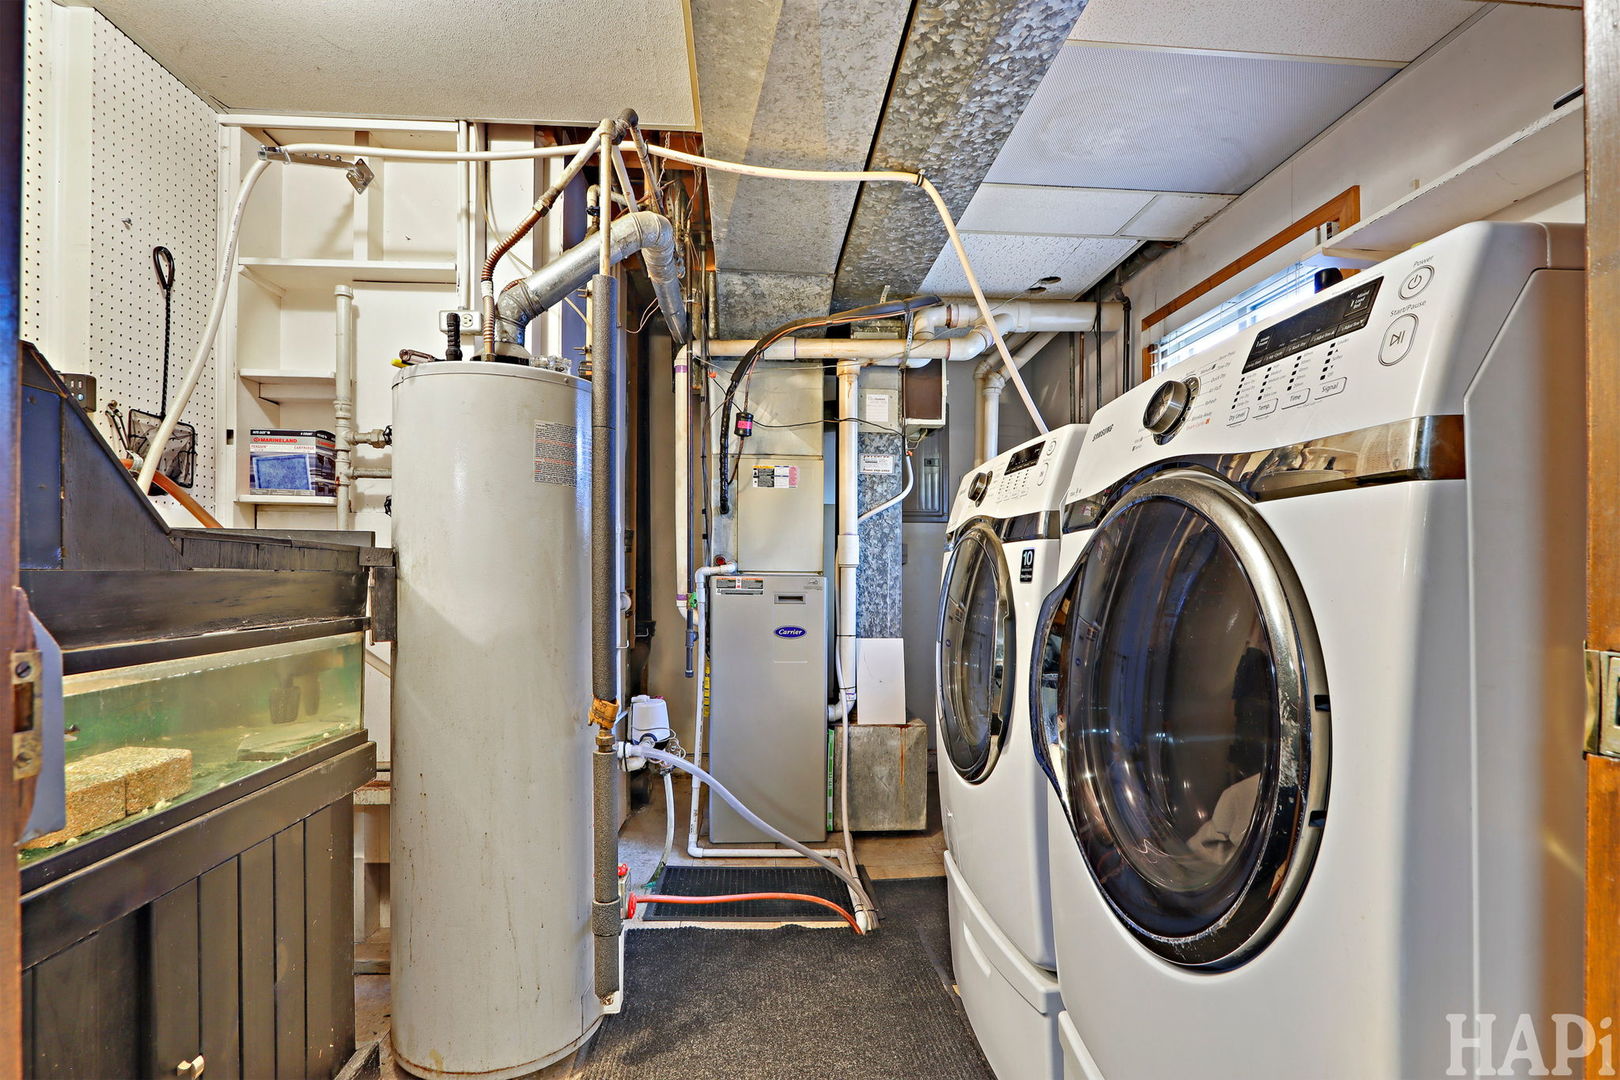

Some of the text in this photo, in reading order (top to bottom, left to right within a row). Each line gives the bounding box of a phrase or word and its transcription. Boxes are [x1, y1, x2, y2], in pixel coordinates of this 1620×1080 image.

[1413, 256, 1434, 267] Power
[1389, 300, 1427, 317] Start/Pause
[1321, 383, 1339, 393] Signal
[1289, 393, 1302, 402] Time
[1228, 414, 1236, 422] Dry
[1092, 424, 1114, 442] SAMSUNG
[1023, 550, 1033, 566] 10
[778, 628, 803, 636] Carrier
